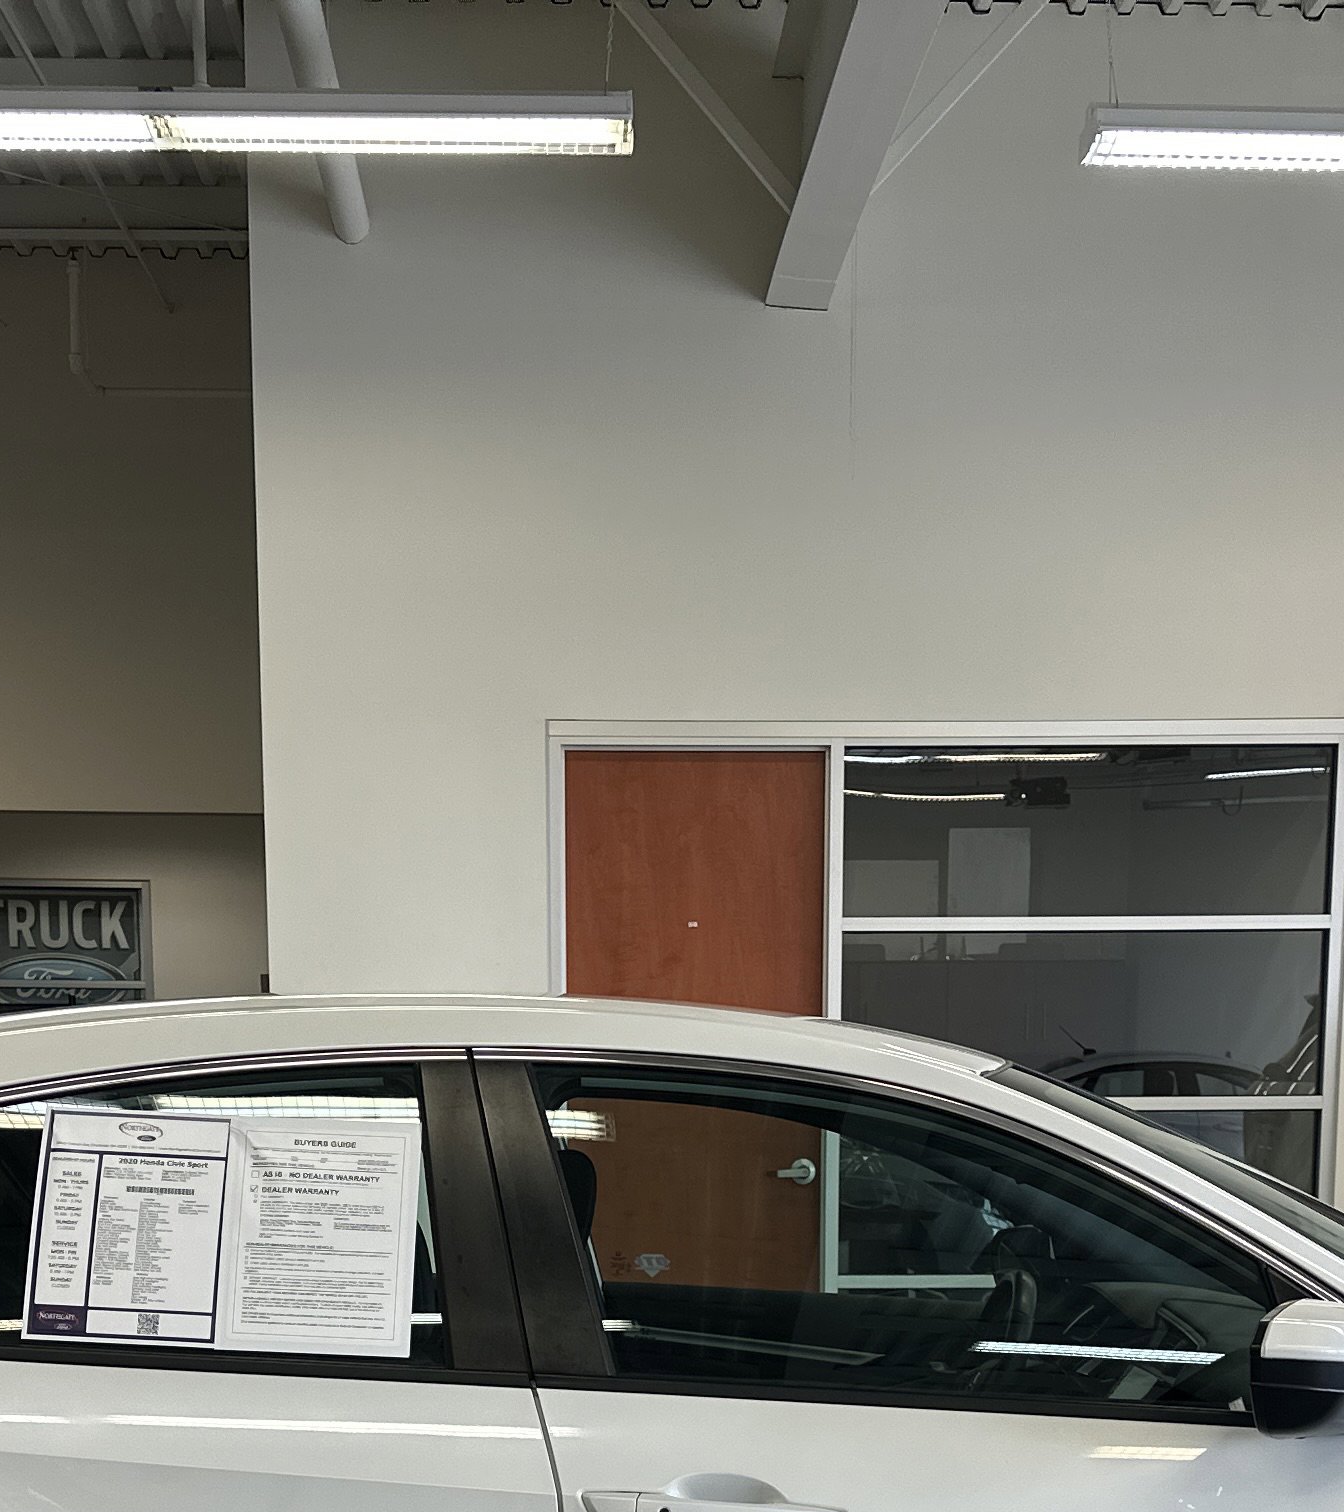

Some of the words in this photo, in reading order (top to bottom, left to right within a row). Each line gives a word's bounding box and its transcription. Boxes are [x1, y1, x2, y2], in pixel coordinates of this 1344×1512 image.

[294, 1139, 328, 1147] BUYERS
[187, 1161, 208, 1169] Sport
[303, 1172, 334, 1180] DEALER
[336, 1174, 380, 1183] WARRANTY
[262, 1186, 293, 1194] DEALER
[295, 1187, 339, 1196] WARRANTY
